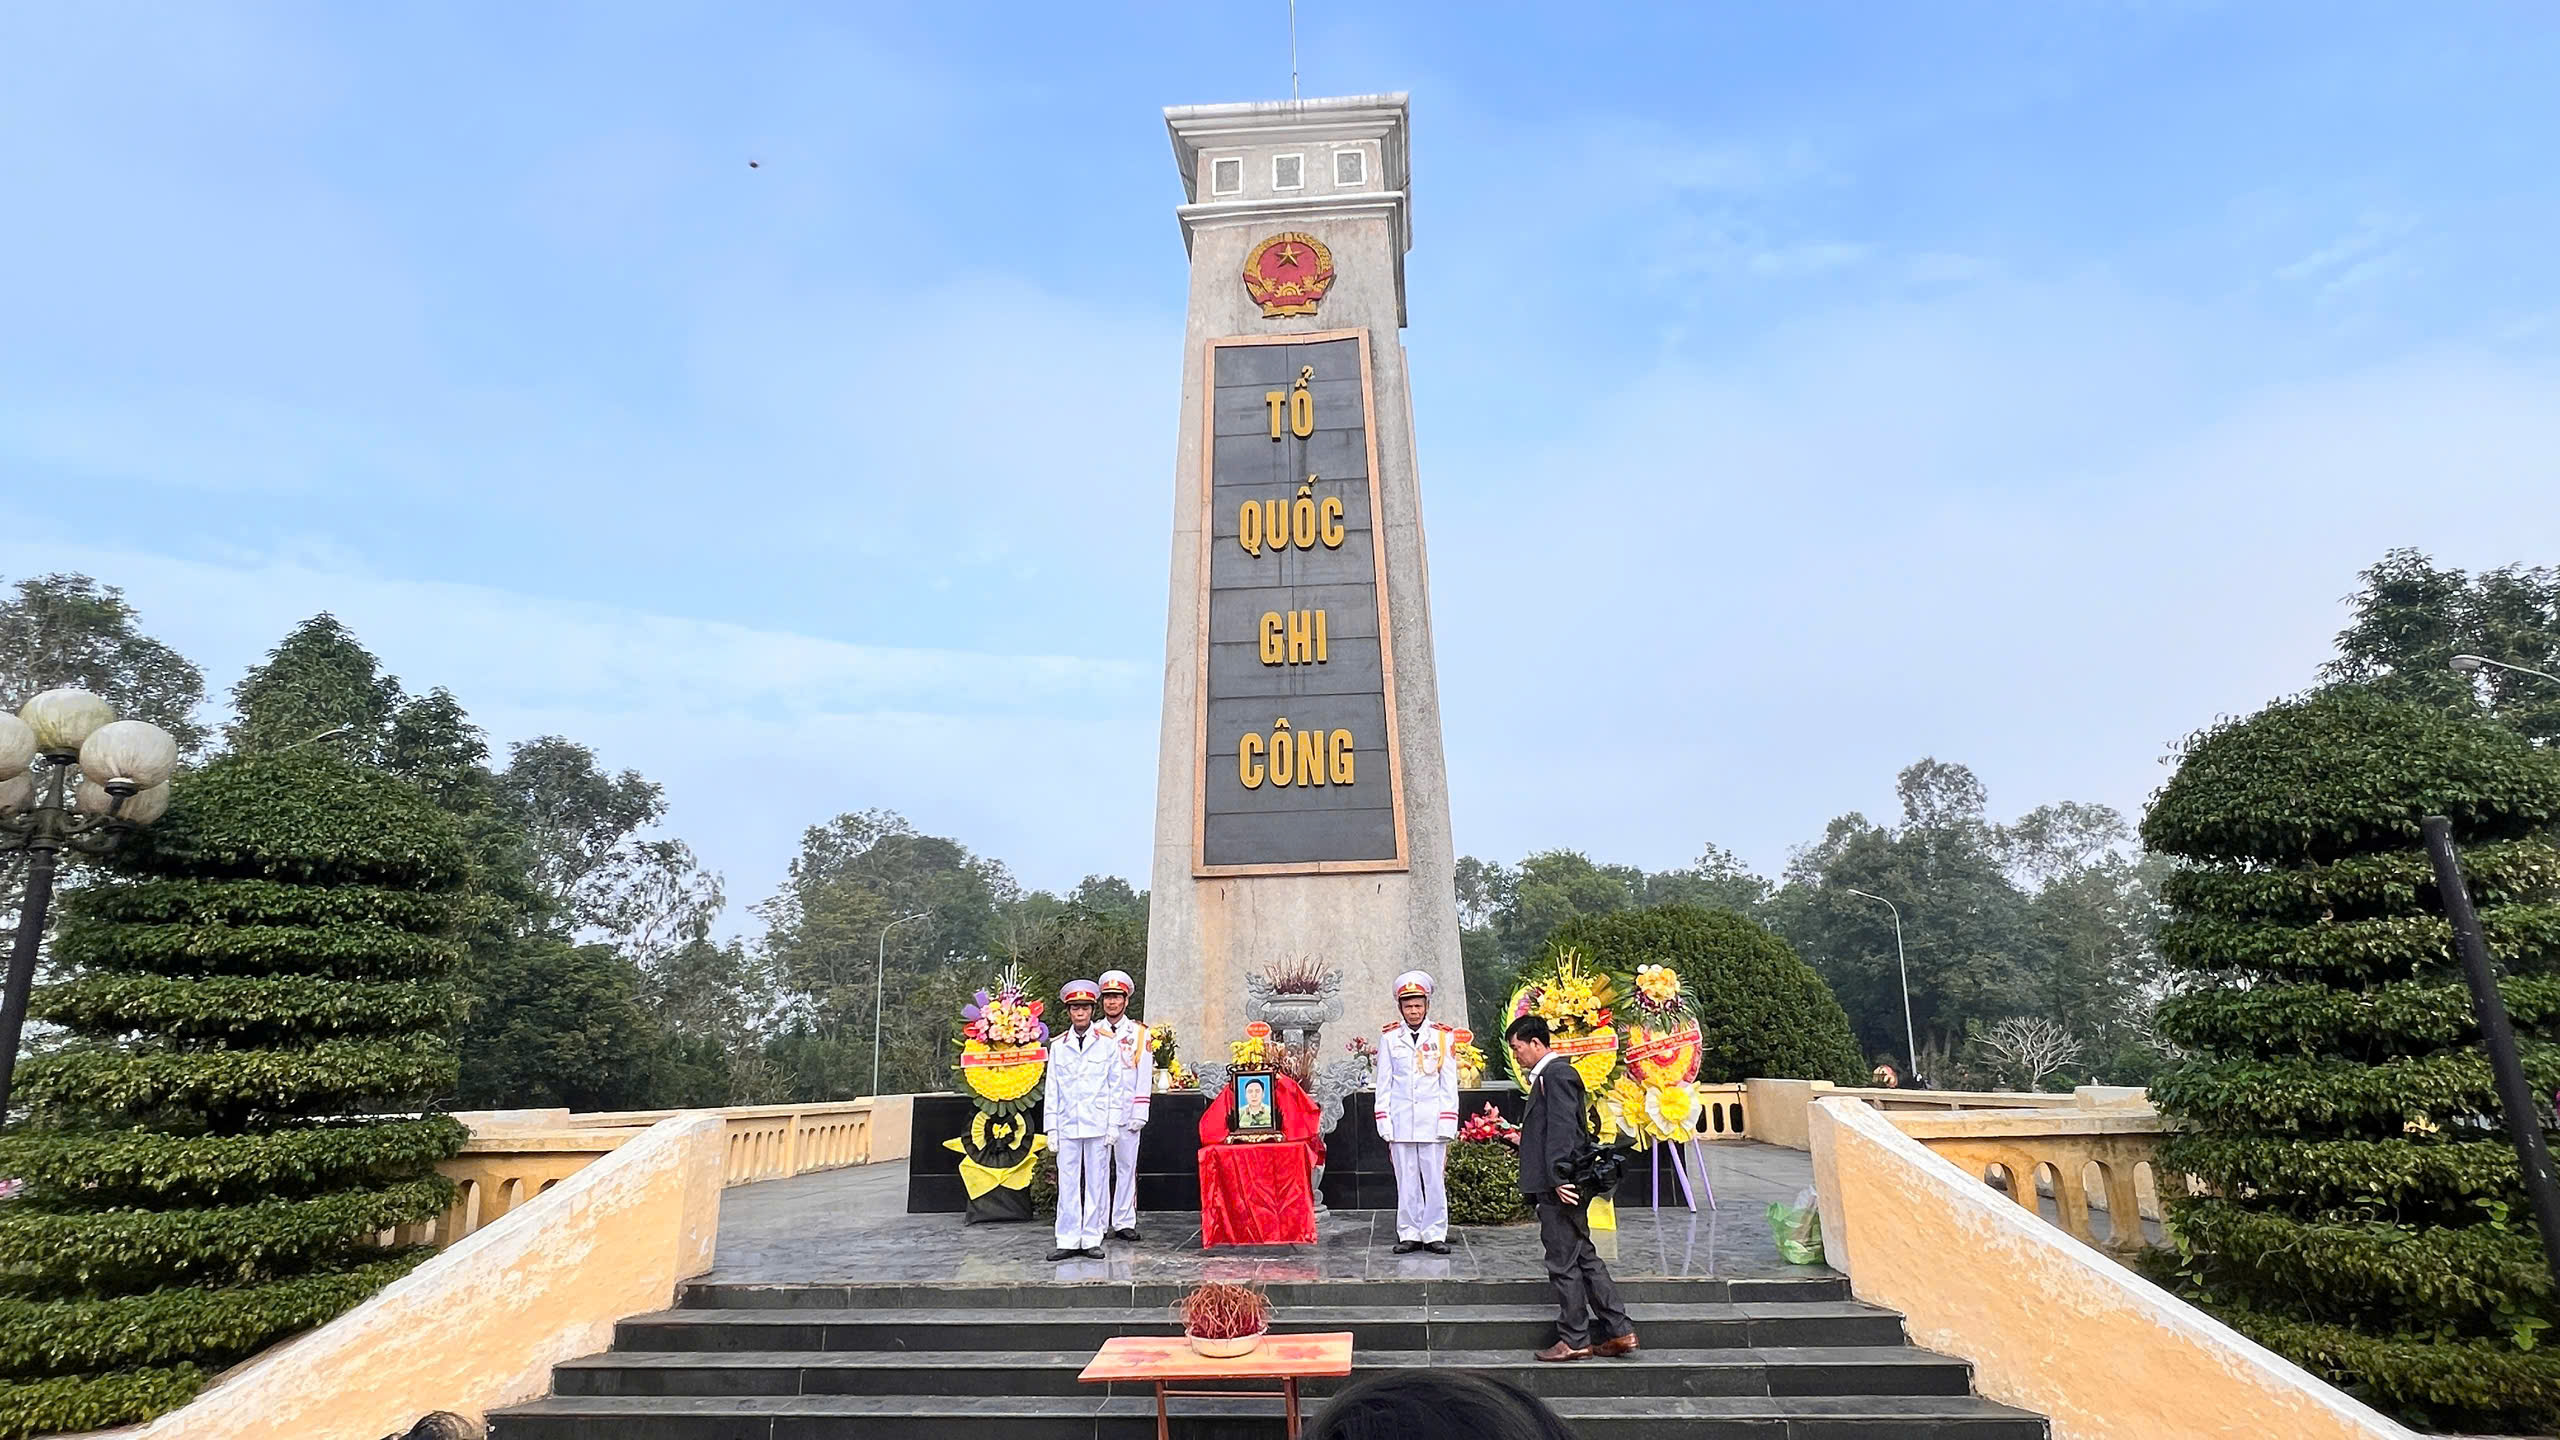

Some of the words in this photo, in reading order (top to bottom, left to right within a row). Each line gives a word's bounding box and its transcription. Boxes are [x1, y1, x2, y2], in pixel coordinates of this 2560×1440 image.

[1266, 365, 1315, 441] TỔ
[1239, 474, 1345, 558] QUỐC
[1259, 609, 1328, 665] GHI
[1239, 717, 1355, 789] CÔNG
